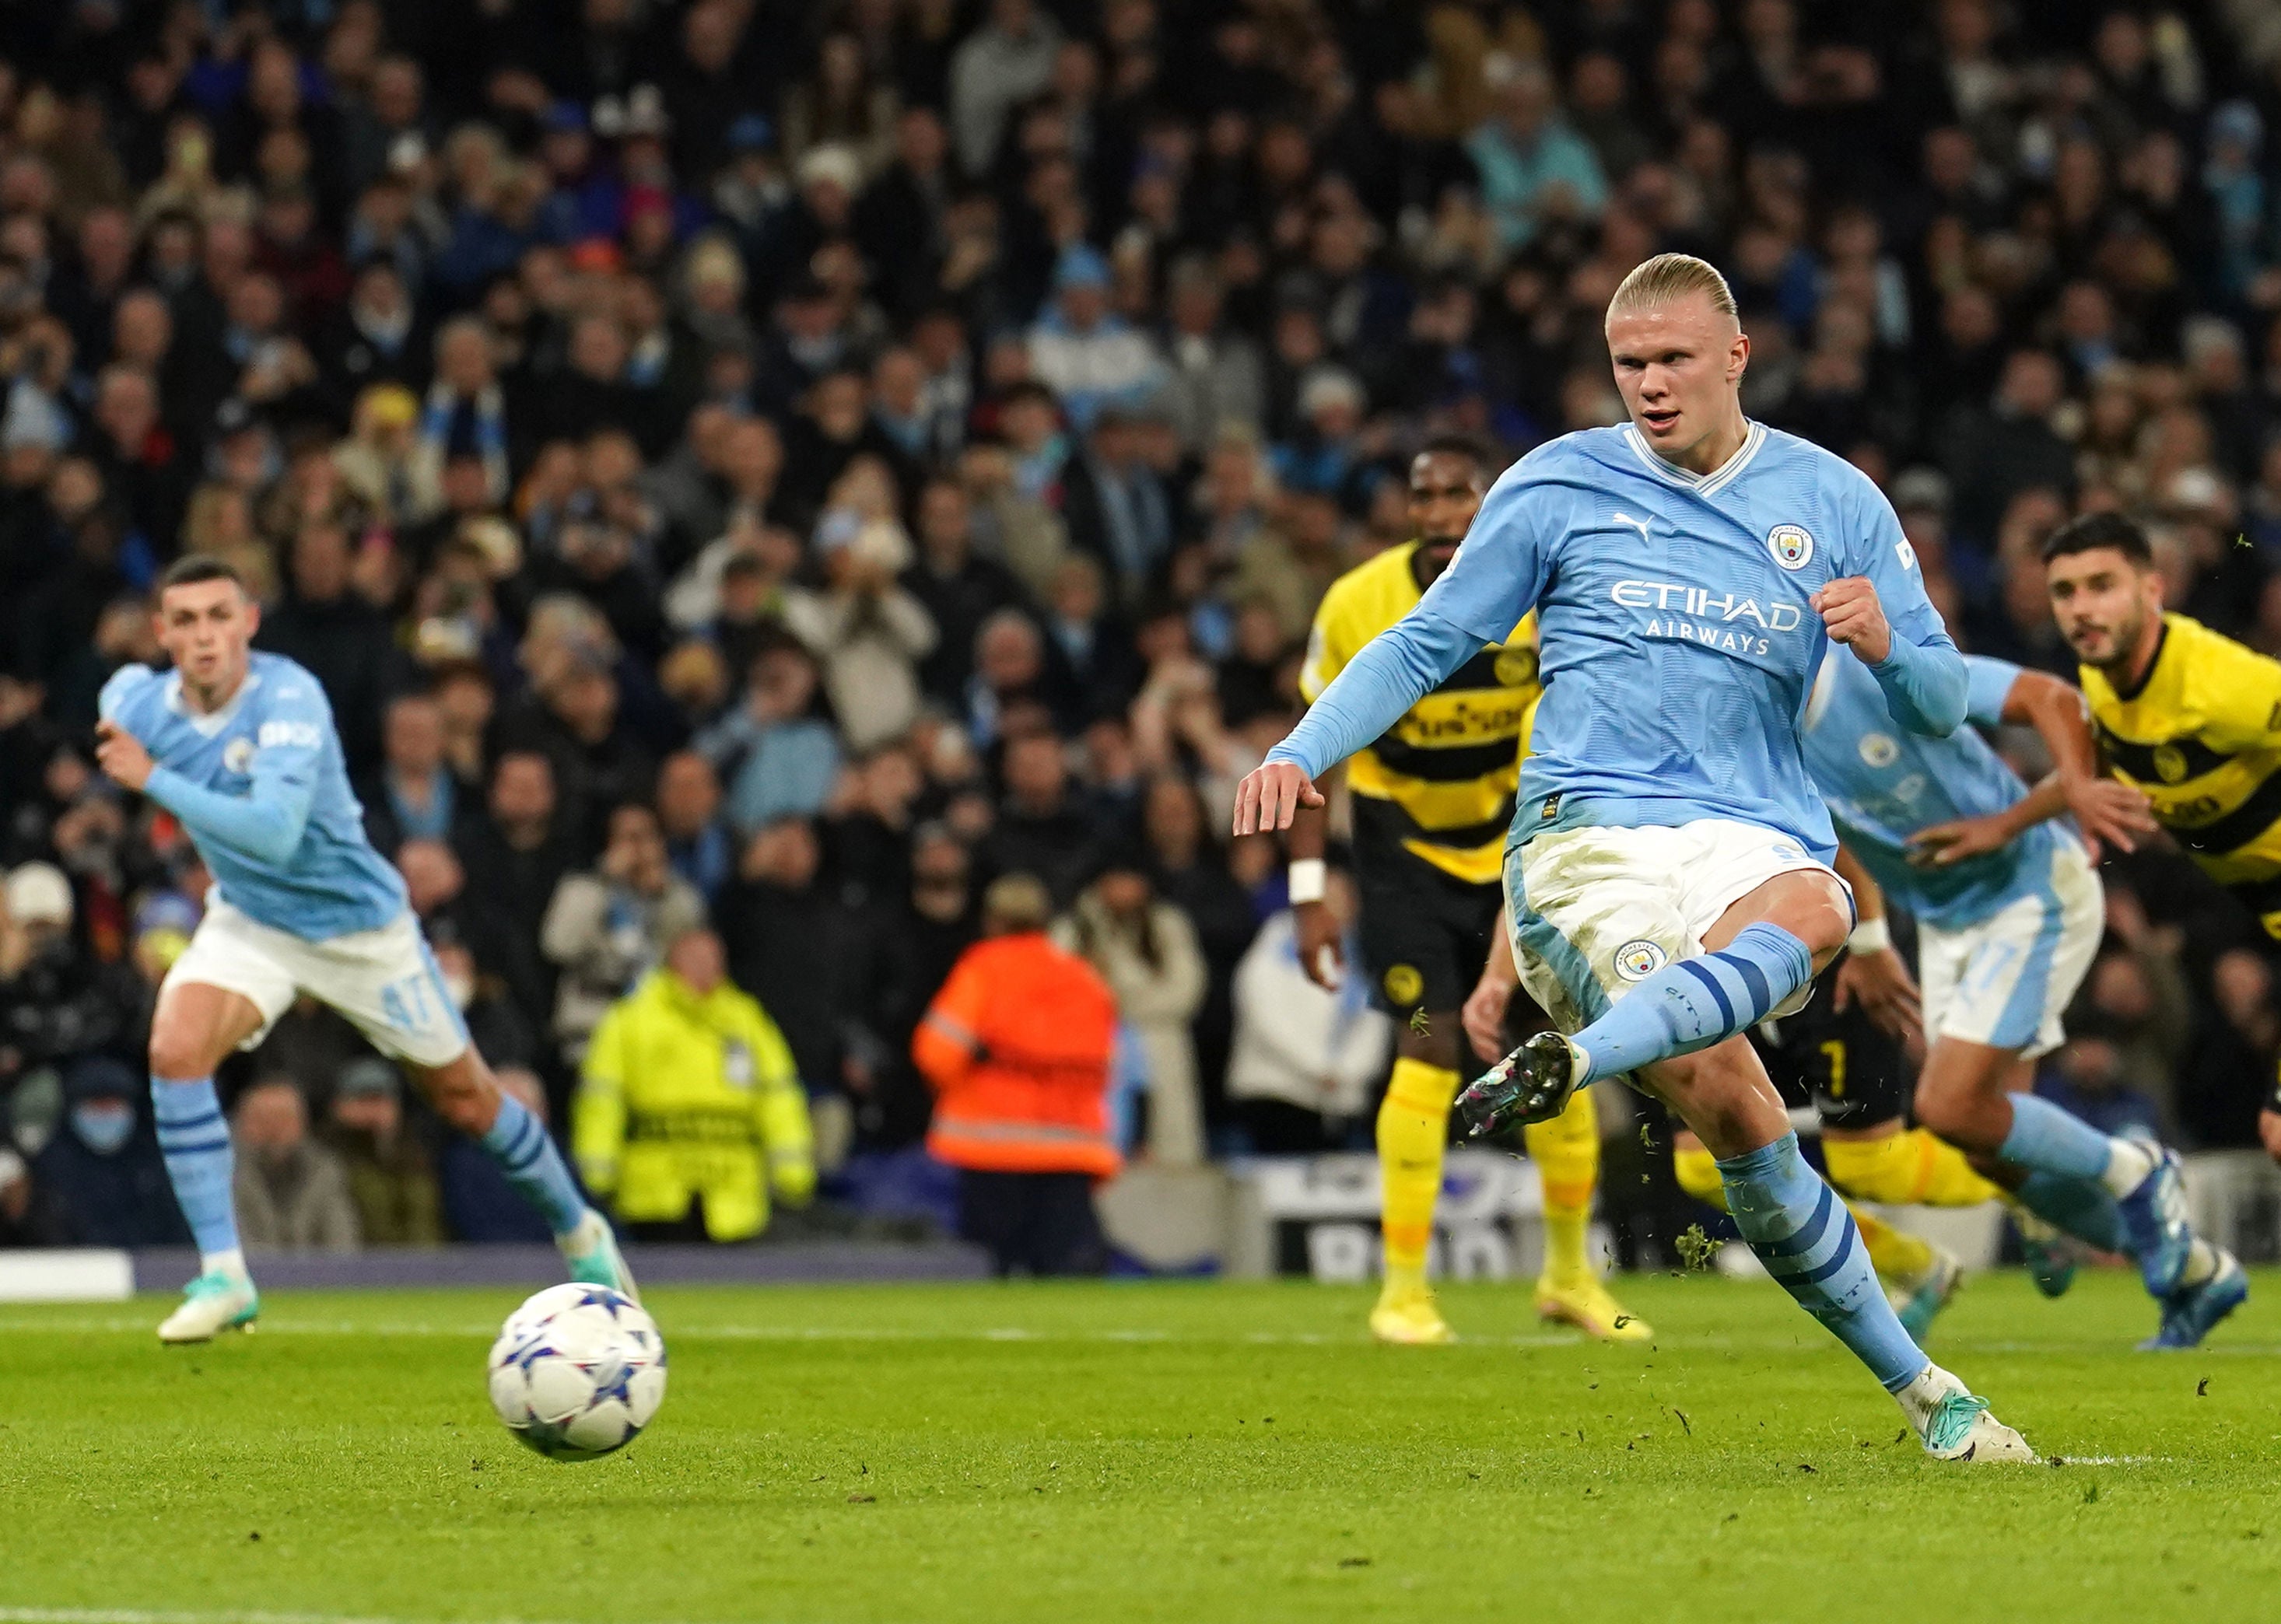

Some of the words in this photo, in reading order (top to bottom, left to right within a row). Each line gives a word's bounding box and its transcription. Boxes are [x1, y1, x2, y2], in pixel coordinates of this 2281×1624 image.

[1611, 579, 1802, 632] ETIHAD
[1645, 618, 1770, 656] AIRWAYS
[1617, 943, 1655, 965] MANCHESTER
[1665, 986, 1702, 1037] CITY
